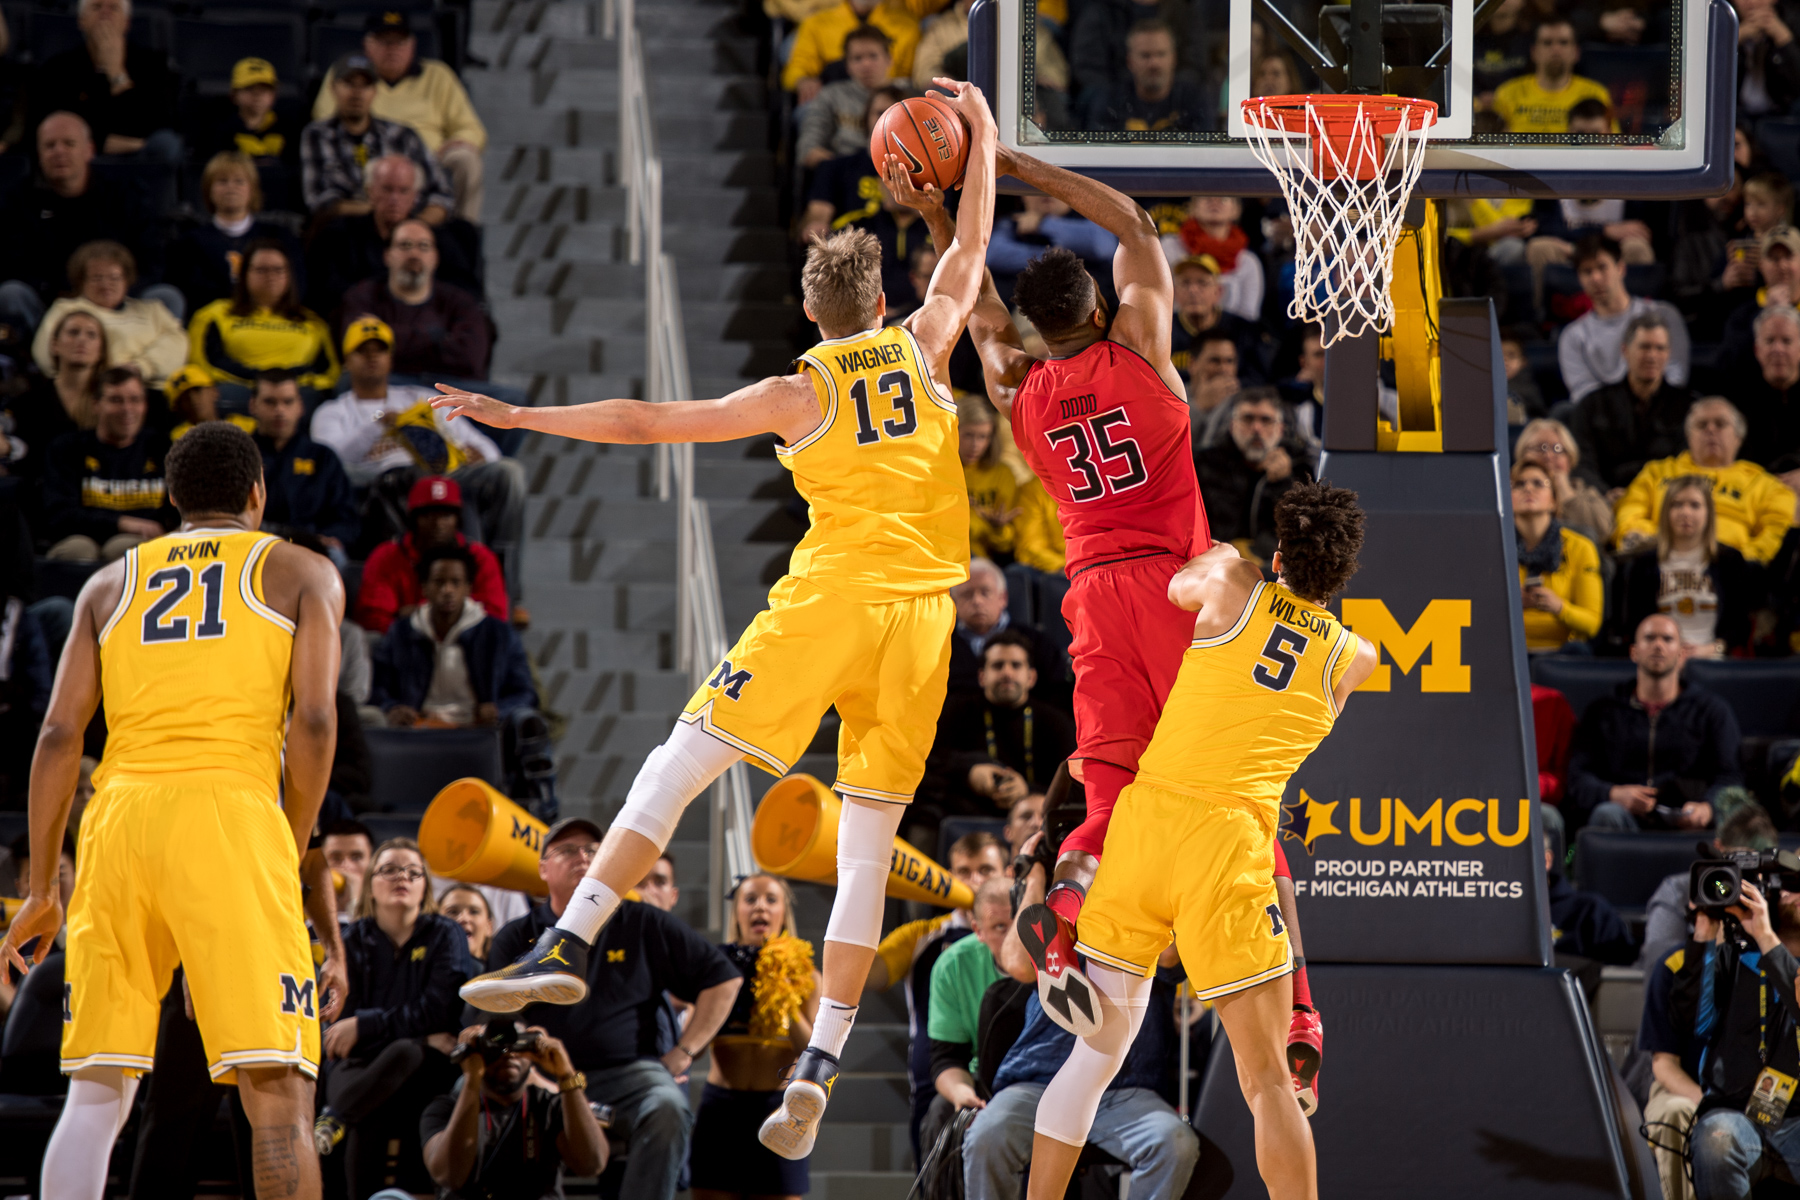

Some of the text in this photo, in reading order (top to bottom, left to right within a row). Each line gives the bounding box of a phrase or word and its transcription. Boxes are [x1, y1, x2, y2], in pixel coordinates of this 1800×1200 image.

[922, 117, 950, 162] ELITE
[835, 343, 906, 374] WAGNER
[849, 368, 919, 447] 13
[1044, 406, 1149, 503] 35
[166, 541, 220, 562] IRVIN
[141, 561, 227, 645] 21
[1268, 593, 1331, 640] WILSON
[1251, 621, 1310, 692] 5
[1341, 598, 1471, 693] M
[706, 659, 754, 703] M
[1349, 797, 1530, 847] UMCU
[1310, 880, 1409, 898] MICHIGAN
[1412, 881, 1523, 898] ATHLETICS
[1314, 859, 1484, 877] PROUD PARTNER
[279, 972, 315, 1020] M
